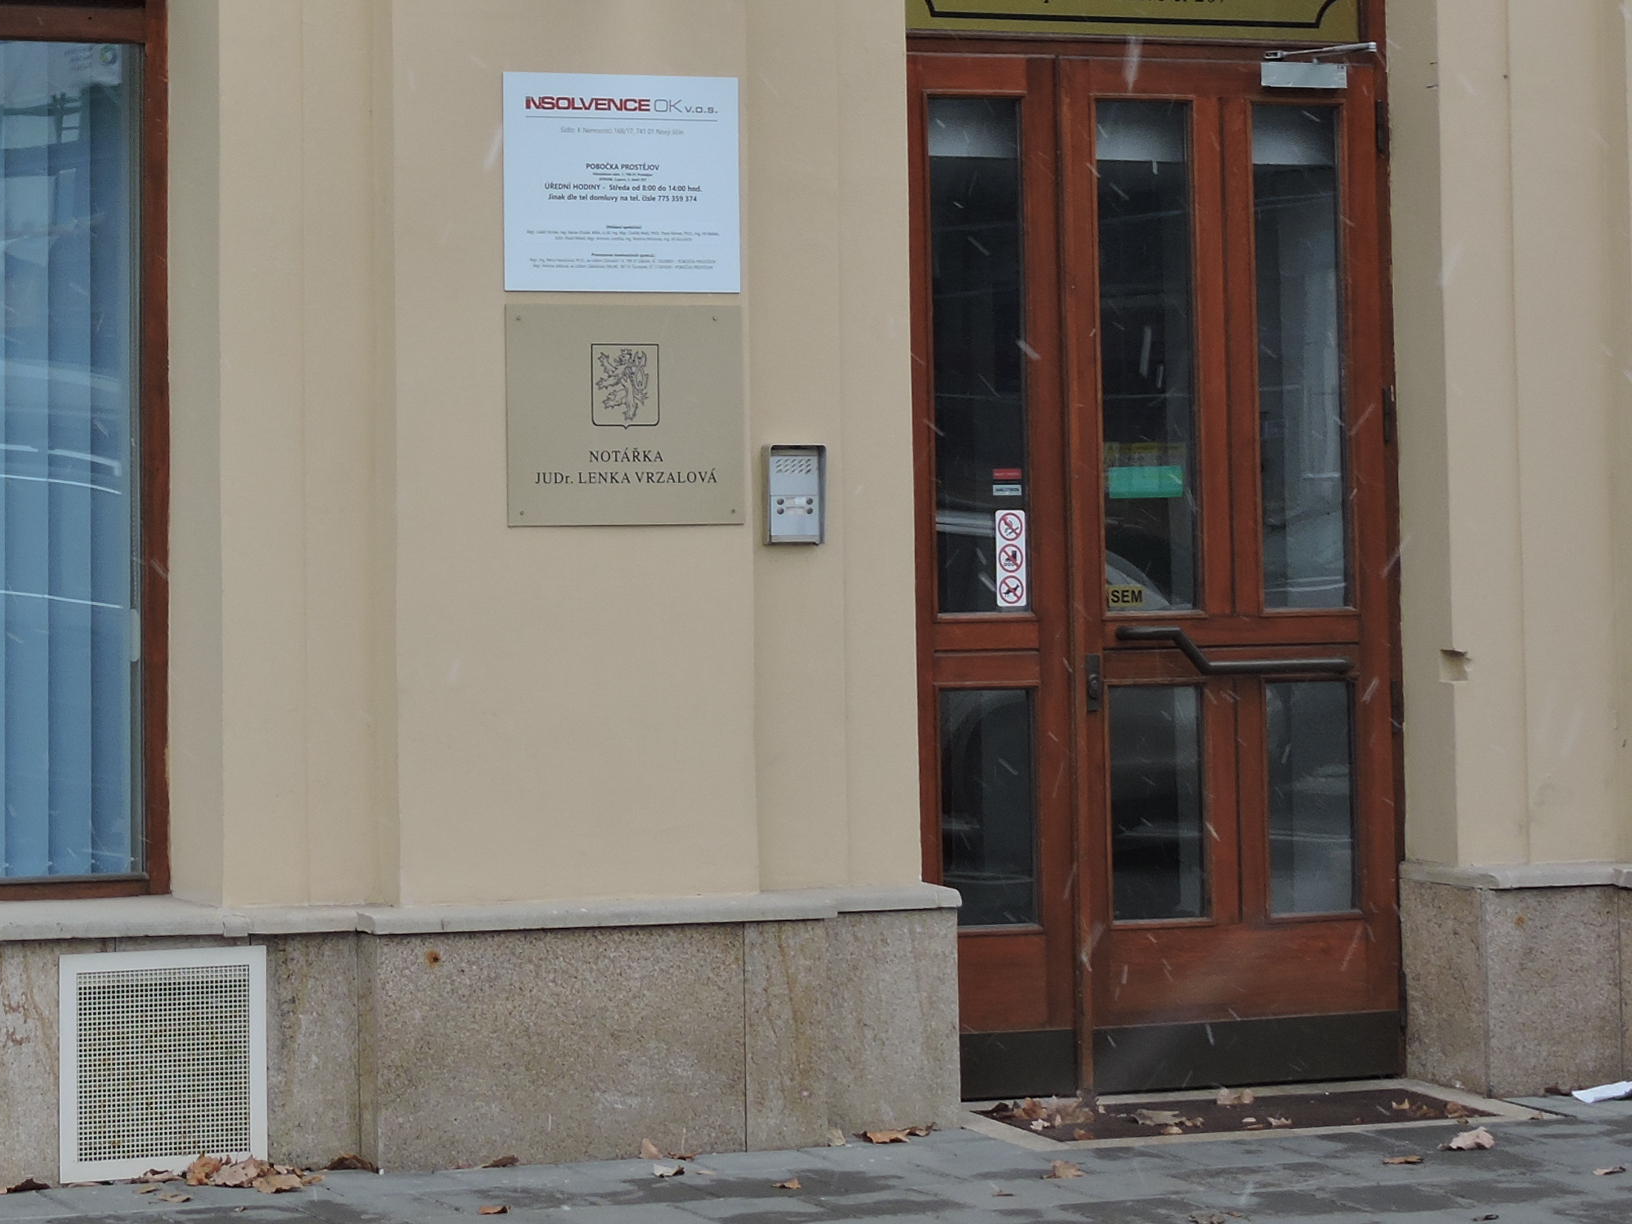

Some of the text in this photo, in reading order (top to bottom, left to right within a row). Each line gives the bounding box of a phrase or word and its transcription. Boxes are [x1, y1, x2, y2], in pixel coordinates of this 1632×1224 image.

[525, 95, 718, 114] INSOLVENCE OK v.o.s.
[586, 162, 619, 171] POBOČKA
[573, 182, 601, 191] HODINY
[609, 183, 630, 192] Středa
[631, 184, 640, 192] od
[642, 184, 656, 192] 8:00
[657, 184, 667, 192] do
[668, 185, 686, 193] 14:00
[548, 193, 565, 201] Jinak
[567, 193, 577, 201] dle
[589, 194, 618, 203] domluvy
[657, 195, 670, 203] 775
[671, 195, 684, 203] 359
[685, 195, 697, 203] 374
[589, 447, 664, 463] NOTÁŘKA
[535, 468, 718, 485] JUDr. LENKA VRZALOVÁ
[1111, 589, 1143, 604] SEM
